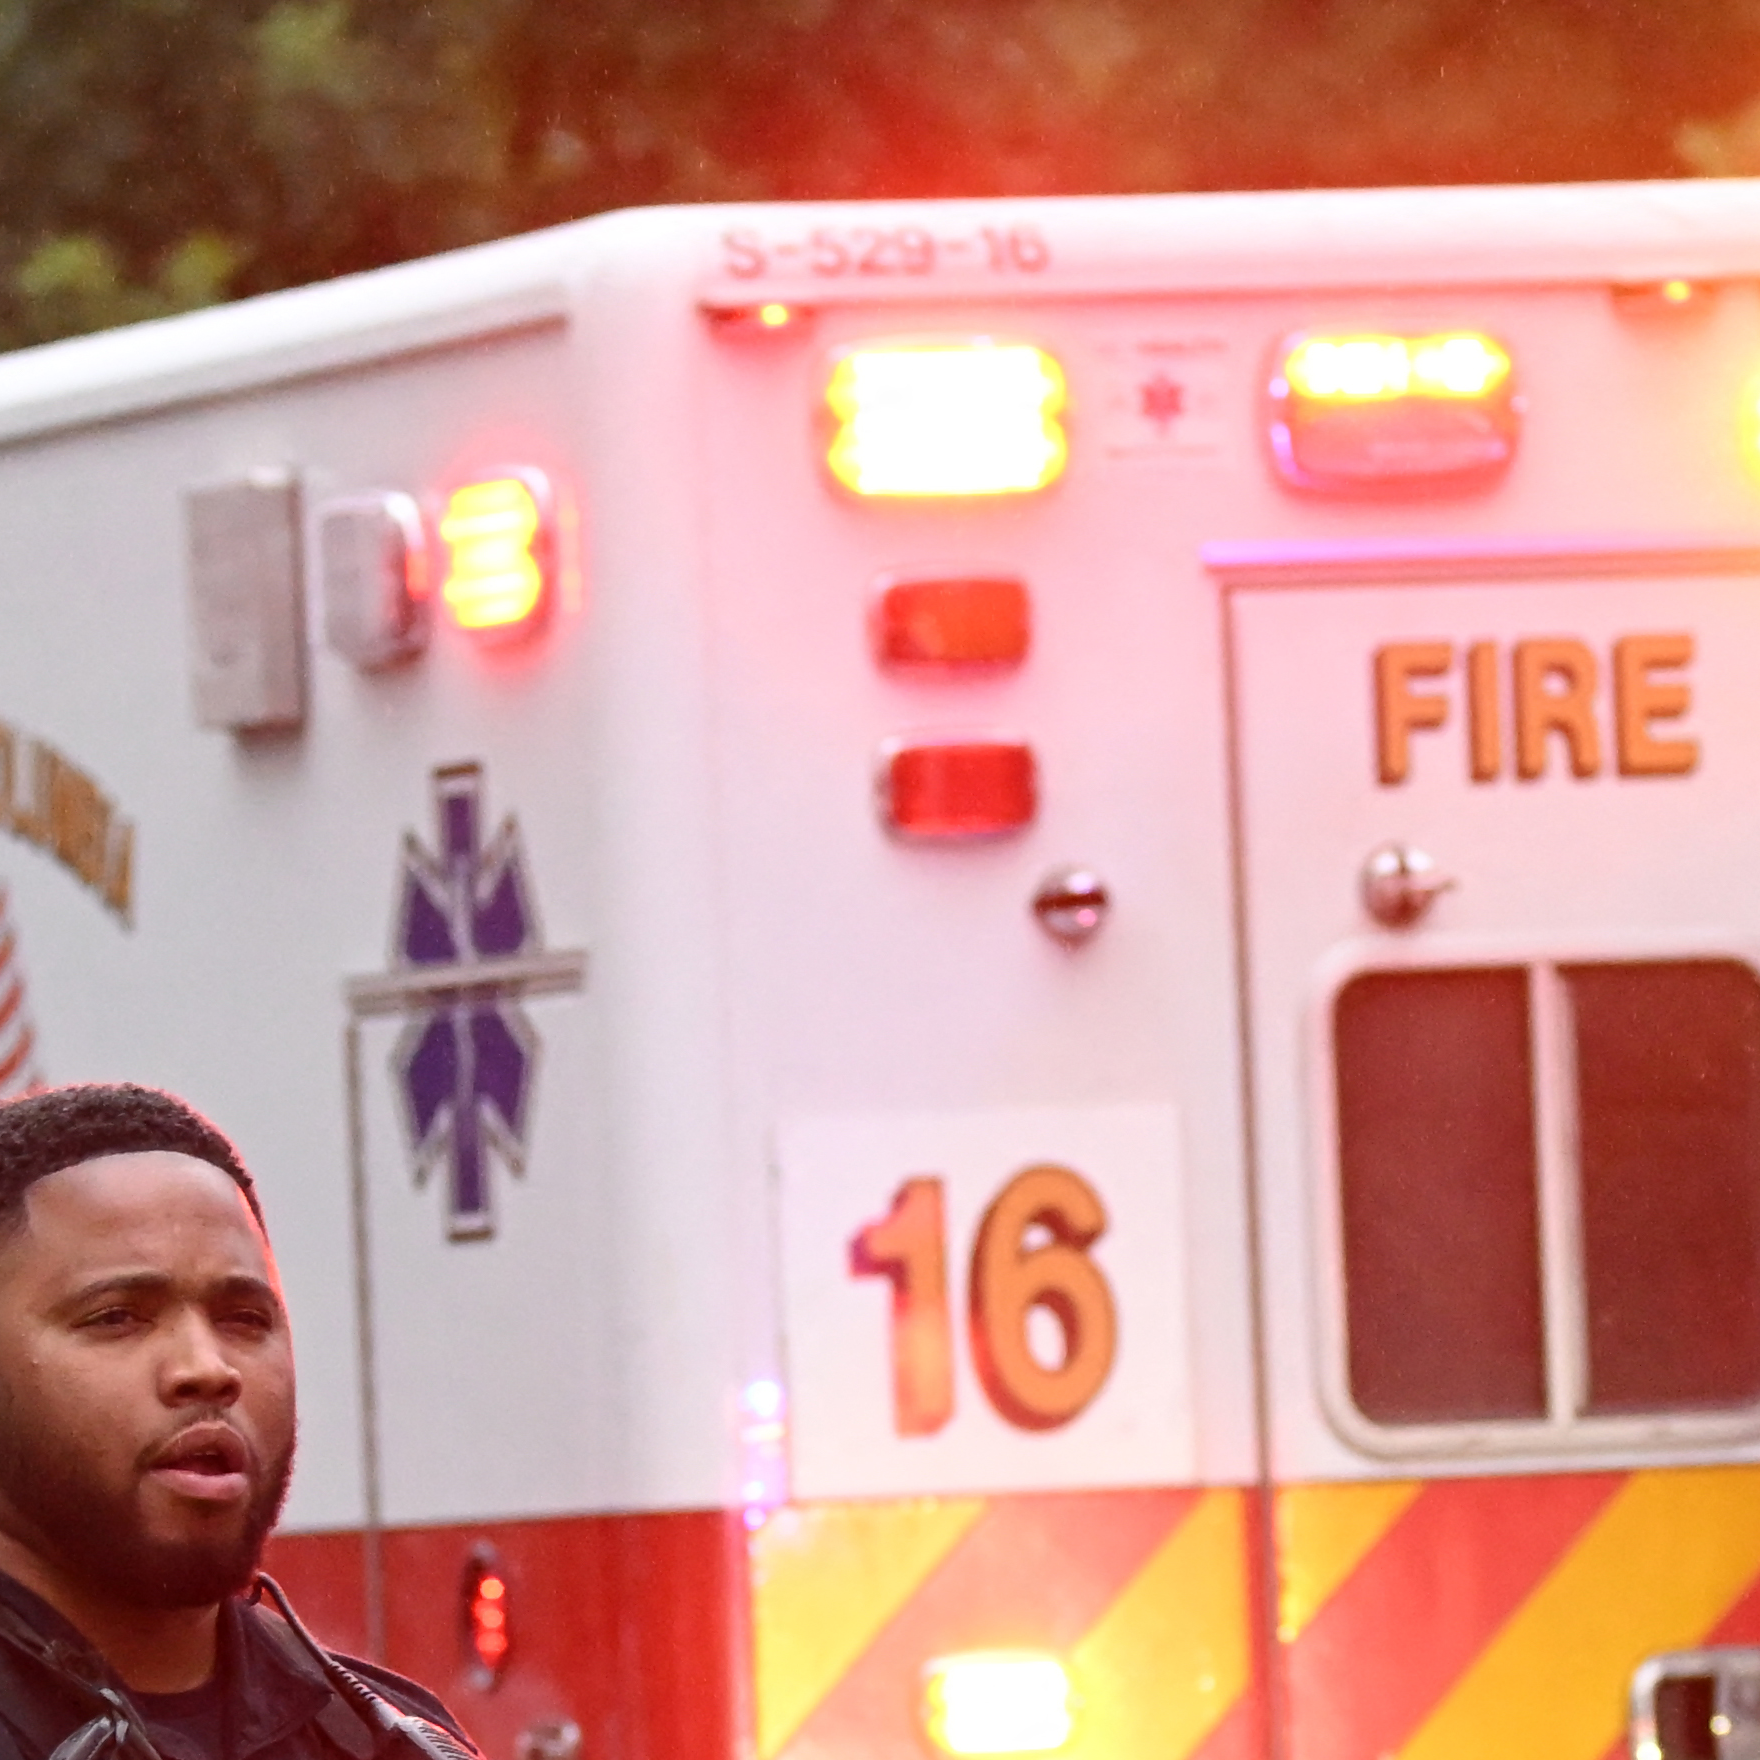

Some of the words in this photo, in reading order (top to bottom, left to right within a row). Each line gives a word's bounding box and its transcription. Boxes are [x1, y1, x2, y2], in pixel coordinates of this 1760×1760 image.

[722, 223, 1051, 279] S-529-16
[1371, 632, 1701, 786] FIRE
[847, 1162, 1119, 1441] 16
